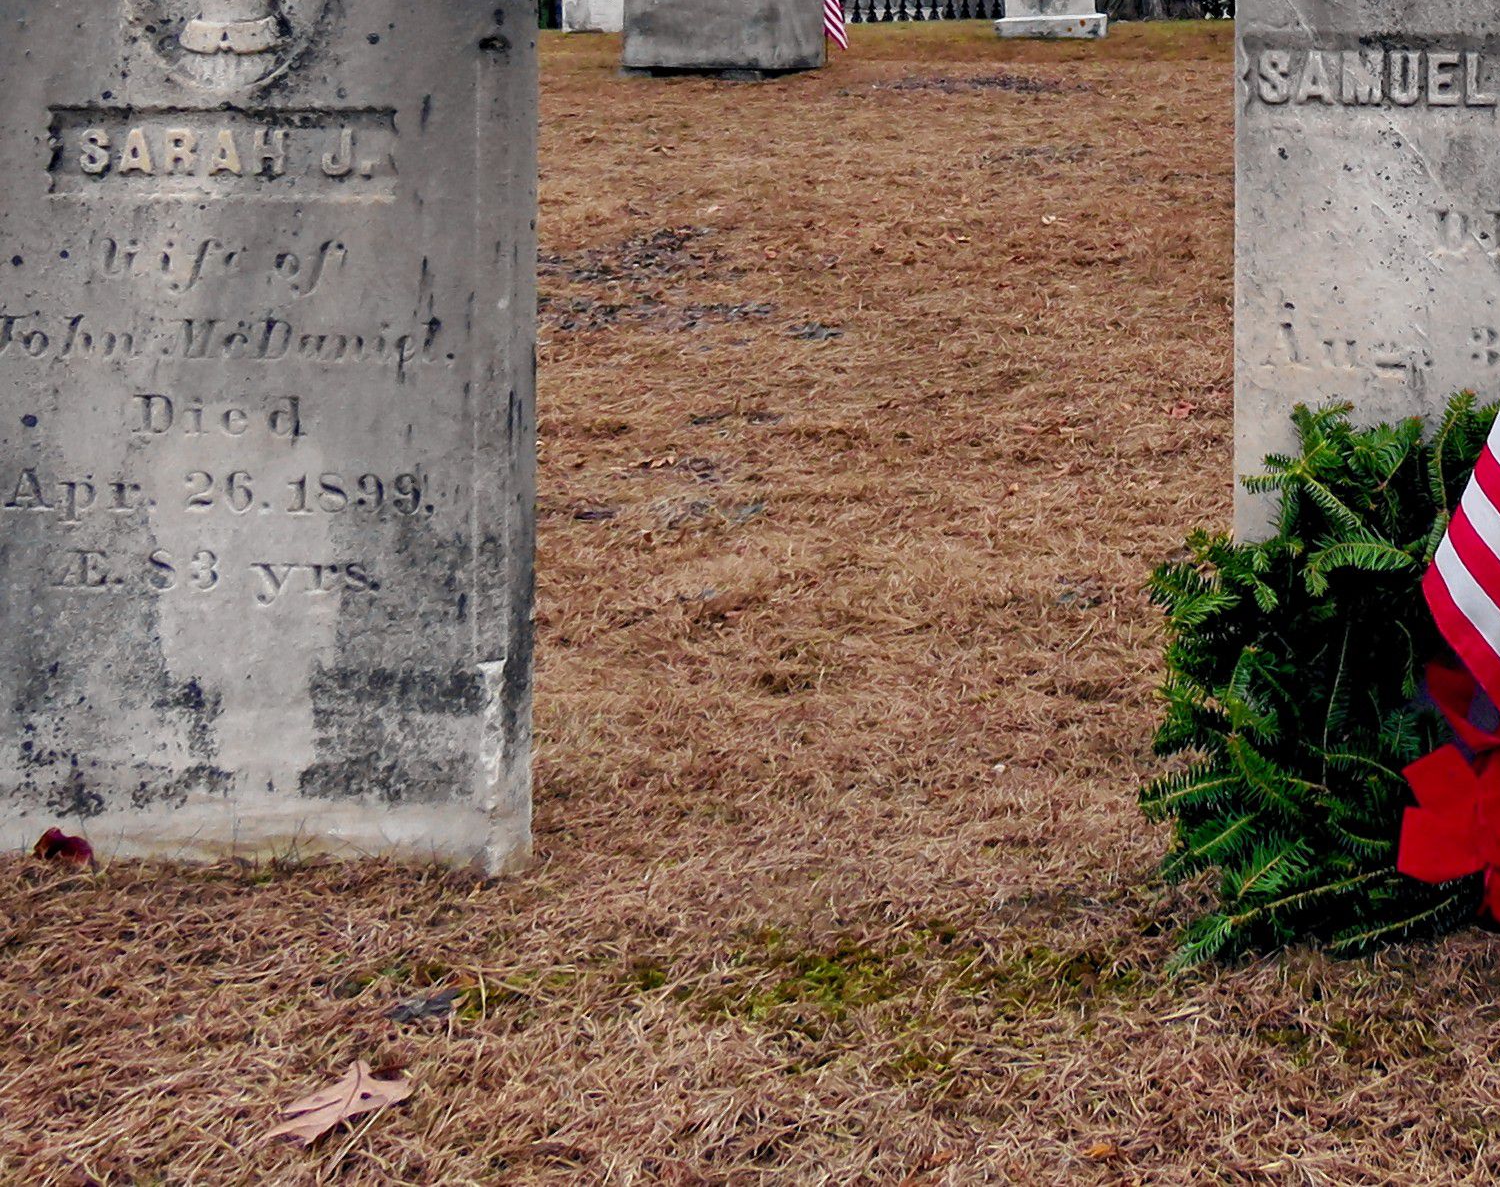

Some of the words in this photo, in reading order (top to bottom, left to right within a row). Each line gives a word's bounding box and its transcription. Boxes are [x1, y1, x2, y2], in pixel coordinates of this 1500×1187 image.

[1256, 49, 1497, 106] SAMUEL
[78, 128, 289, 177] SARAH
[321, 127, 376, 180] J.
[274, 237, 348, 296] of
[0, 314, 136, 359] John
[131, 393, 308, 437] Died
[4, 469, 156, 523] Apr.
[184, 471, 271, 513] 26.
[286, 471, 435, 515] 1899.
[148, 550, 221, 591] 83
[249, 559, 381, 606] yrs.
